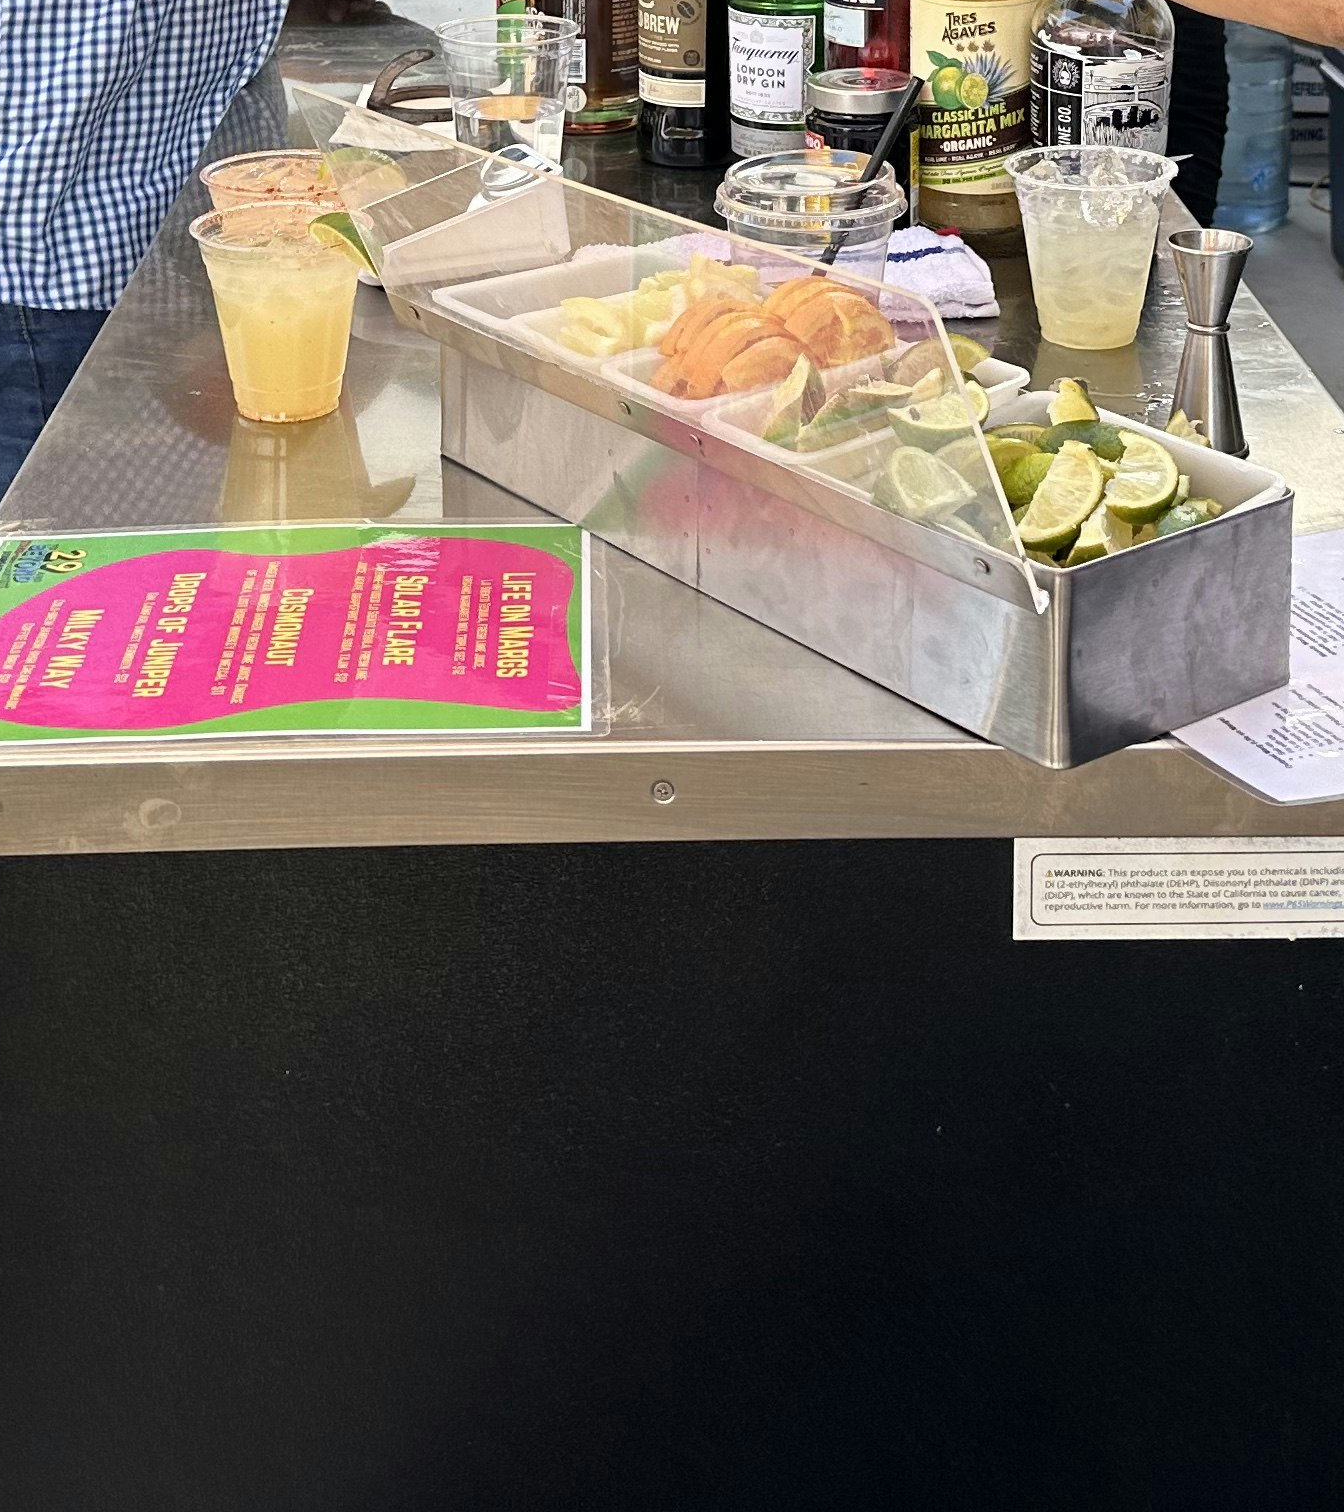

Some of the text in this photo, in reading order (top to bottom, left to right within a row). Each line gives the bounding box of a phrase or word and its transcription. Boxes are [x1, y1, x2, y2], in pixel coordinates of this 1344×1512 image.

[644, 12, 680, 35] BREW
[942, 21, 997, 45] AGAVES
[946, 12, 977, 30] TRES
[732, 36, 800, 65] Tanqueray
[736, 74, 786, 89] DRY GIN
[737, 64, 786, 78] LONDON
[932, 102, 1007, 123] CLASSIC LIME
[1000, 108, 1025, 130] MIX
[943, 135, 993, 153] ORGANIC
[45, 549, 88, 573] 29
[264, 588, 315, 667] COSMONAUT
[381, 575, 430, 665] SOLAR FLARE
[497, 572, 536, 678] LIFE ON MARGS
[131, 572, 208, 697] DROPS OF JUNIPER
[38, 609, 104, 689] MILKY WAY
